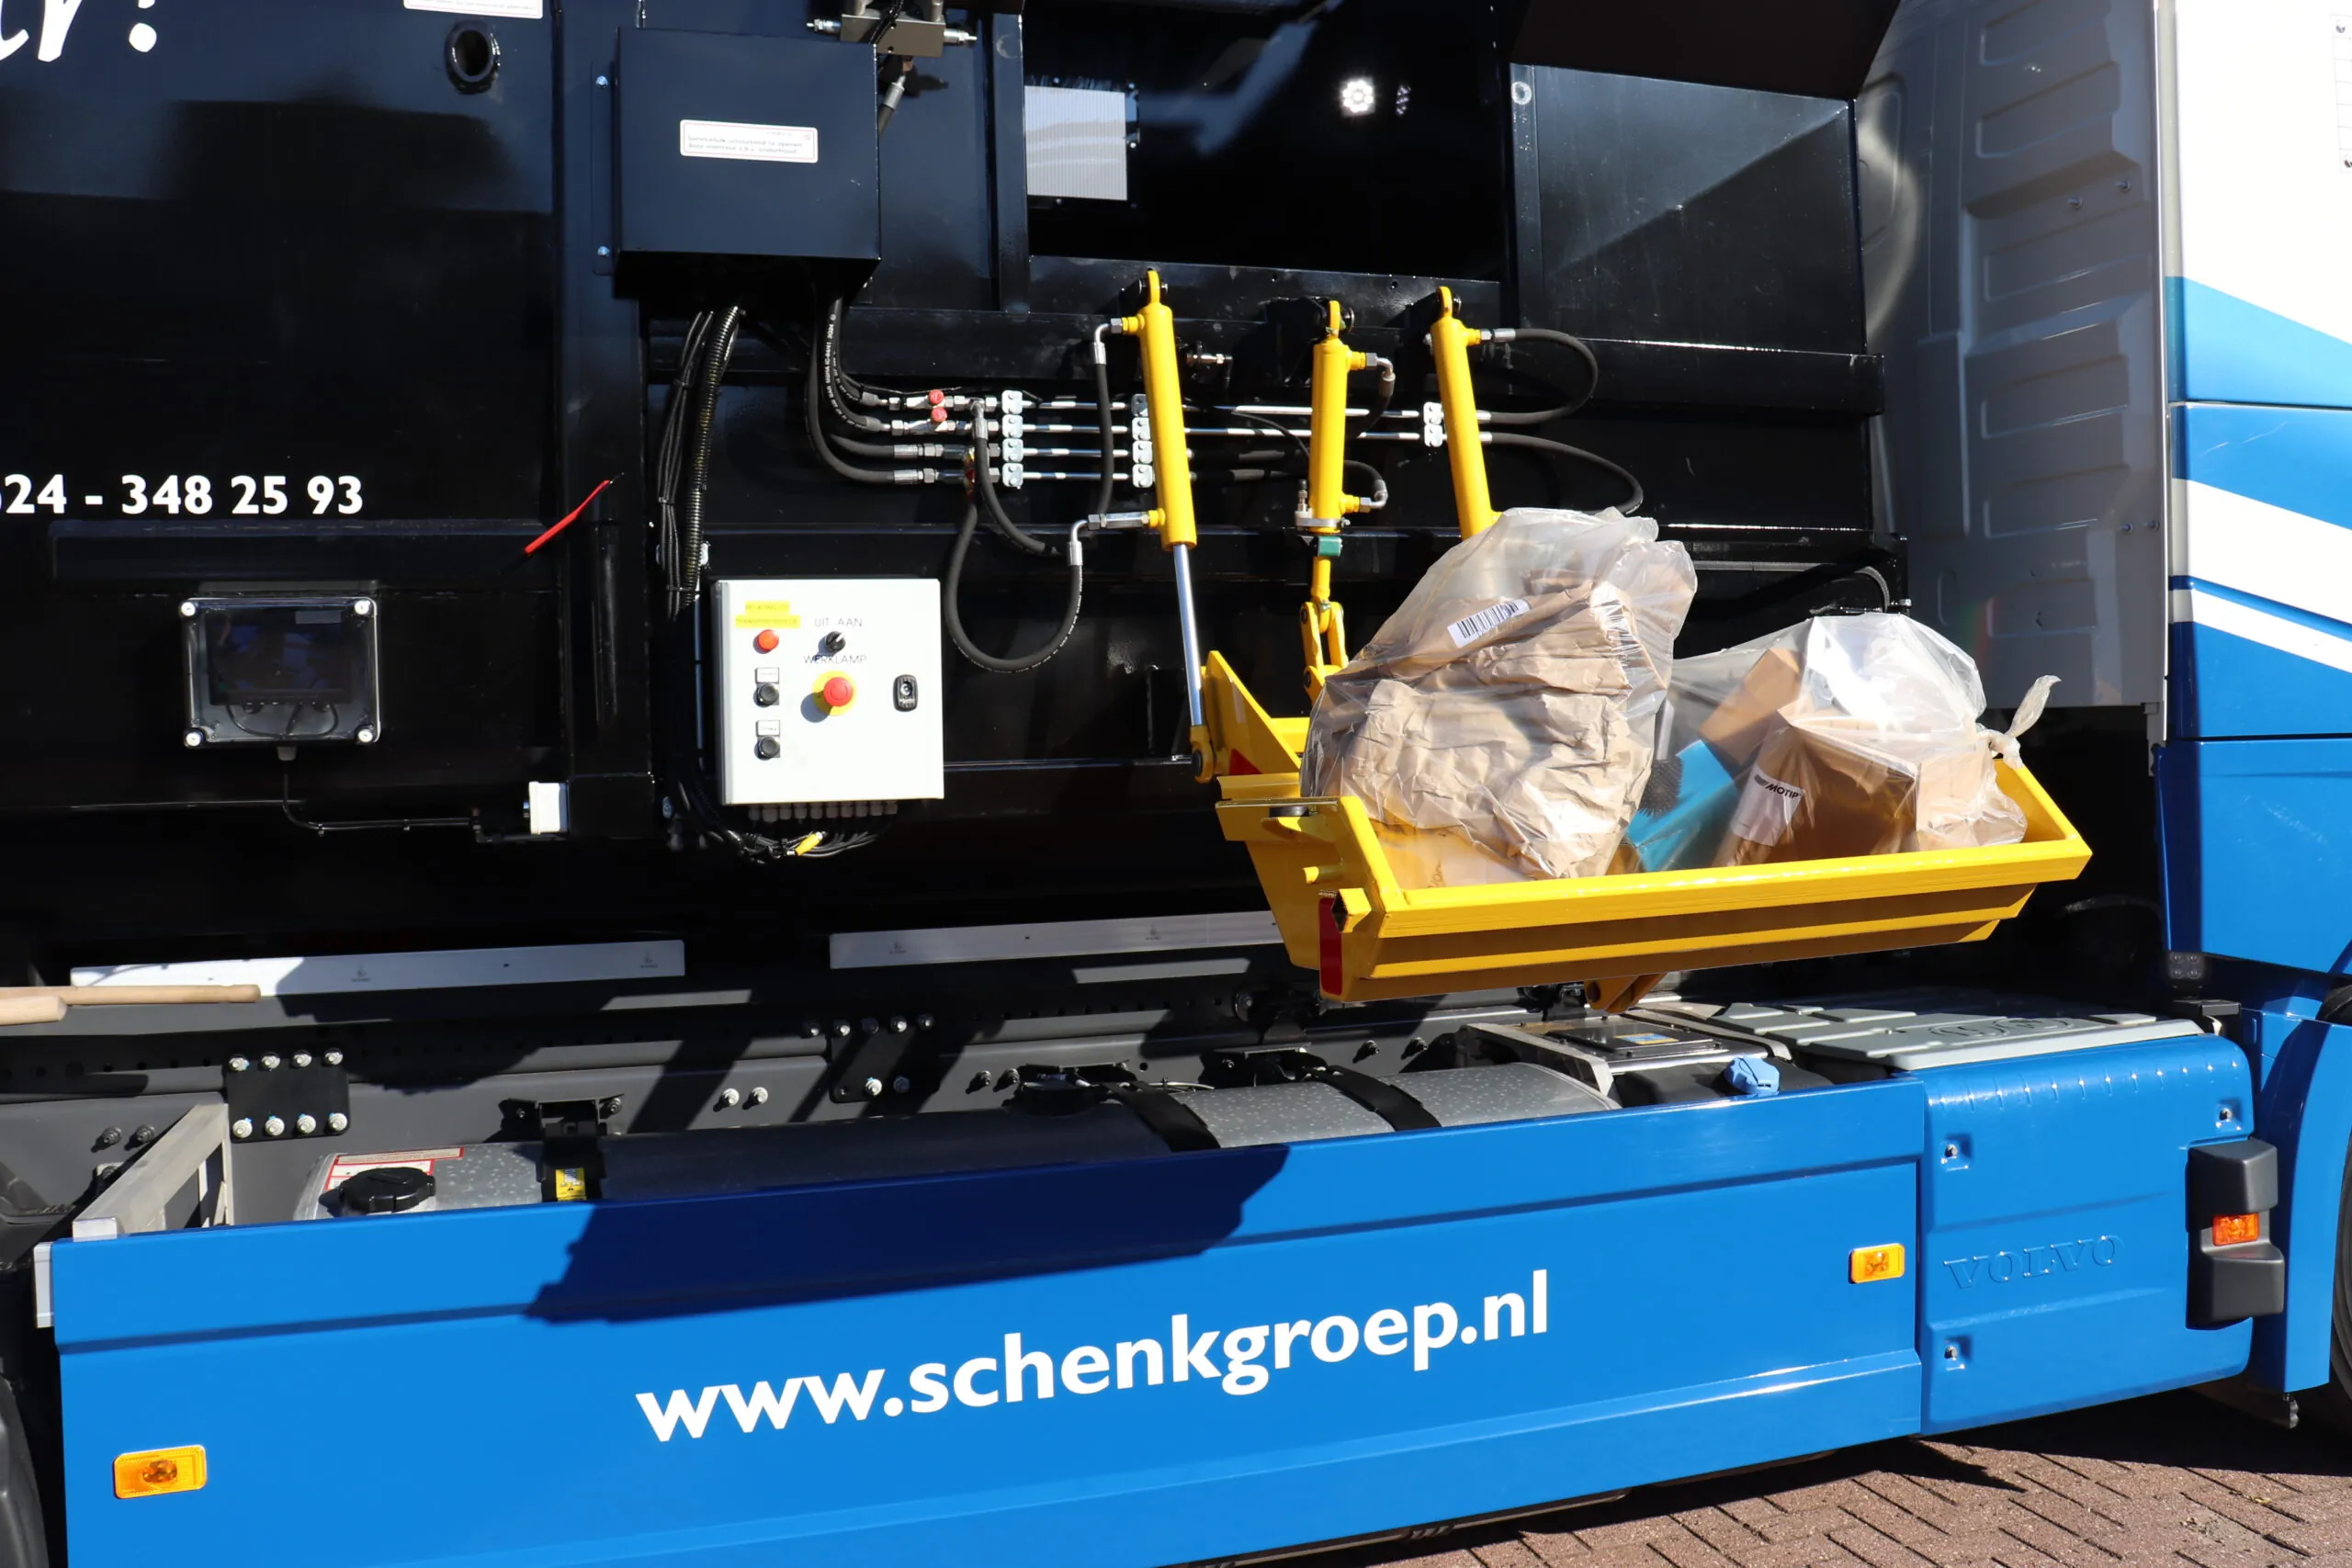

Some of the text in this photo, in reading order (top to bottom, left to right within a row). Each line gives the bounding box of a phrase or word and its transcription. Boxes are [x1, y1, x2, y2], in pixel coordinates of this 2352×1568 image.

[0, 473, 67, 514] 24
[121, 474, 213, 514] 348
[231, 475, 288, 514] 25
[307, 475, 363, 514] 93
[837, 617, 863, 627] AAN
[1765, 784, 1800, 799] MOTIP
[1942, 1235, 2126, 1290] VOLVO
[635, 1269, 1547, 1442] www.schenkgroep.nl
